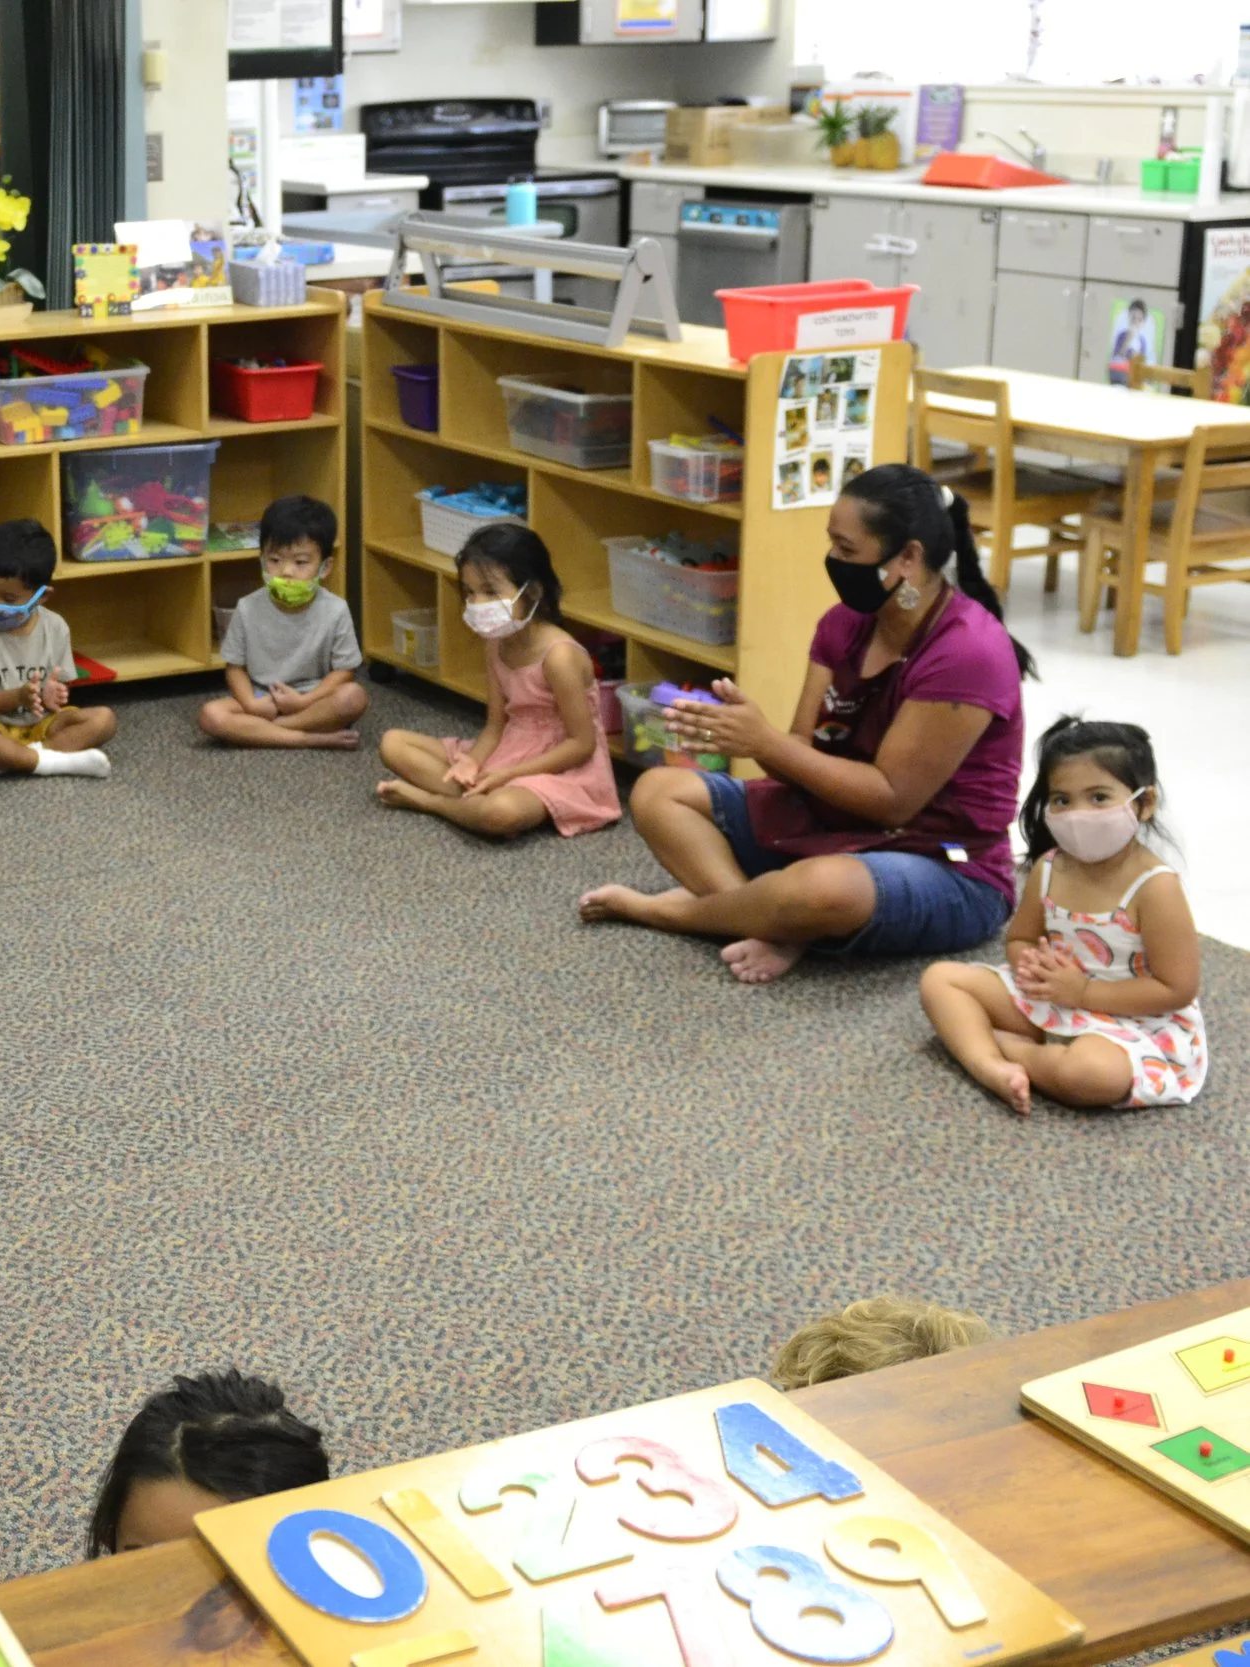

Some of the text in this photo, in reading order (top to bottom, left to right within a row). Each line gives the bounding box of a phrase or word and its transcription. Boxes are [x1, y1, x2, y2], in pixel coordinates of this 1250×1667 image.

[574, 1436, 740, 1541] 3
[713, 1402, 864, 1507] 4
[716, 1545, 895, 1664] 8
[823, 1516, 988, 1628] 9
